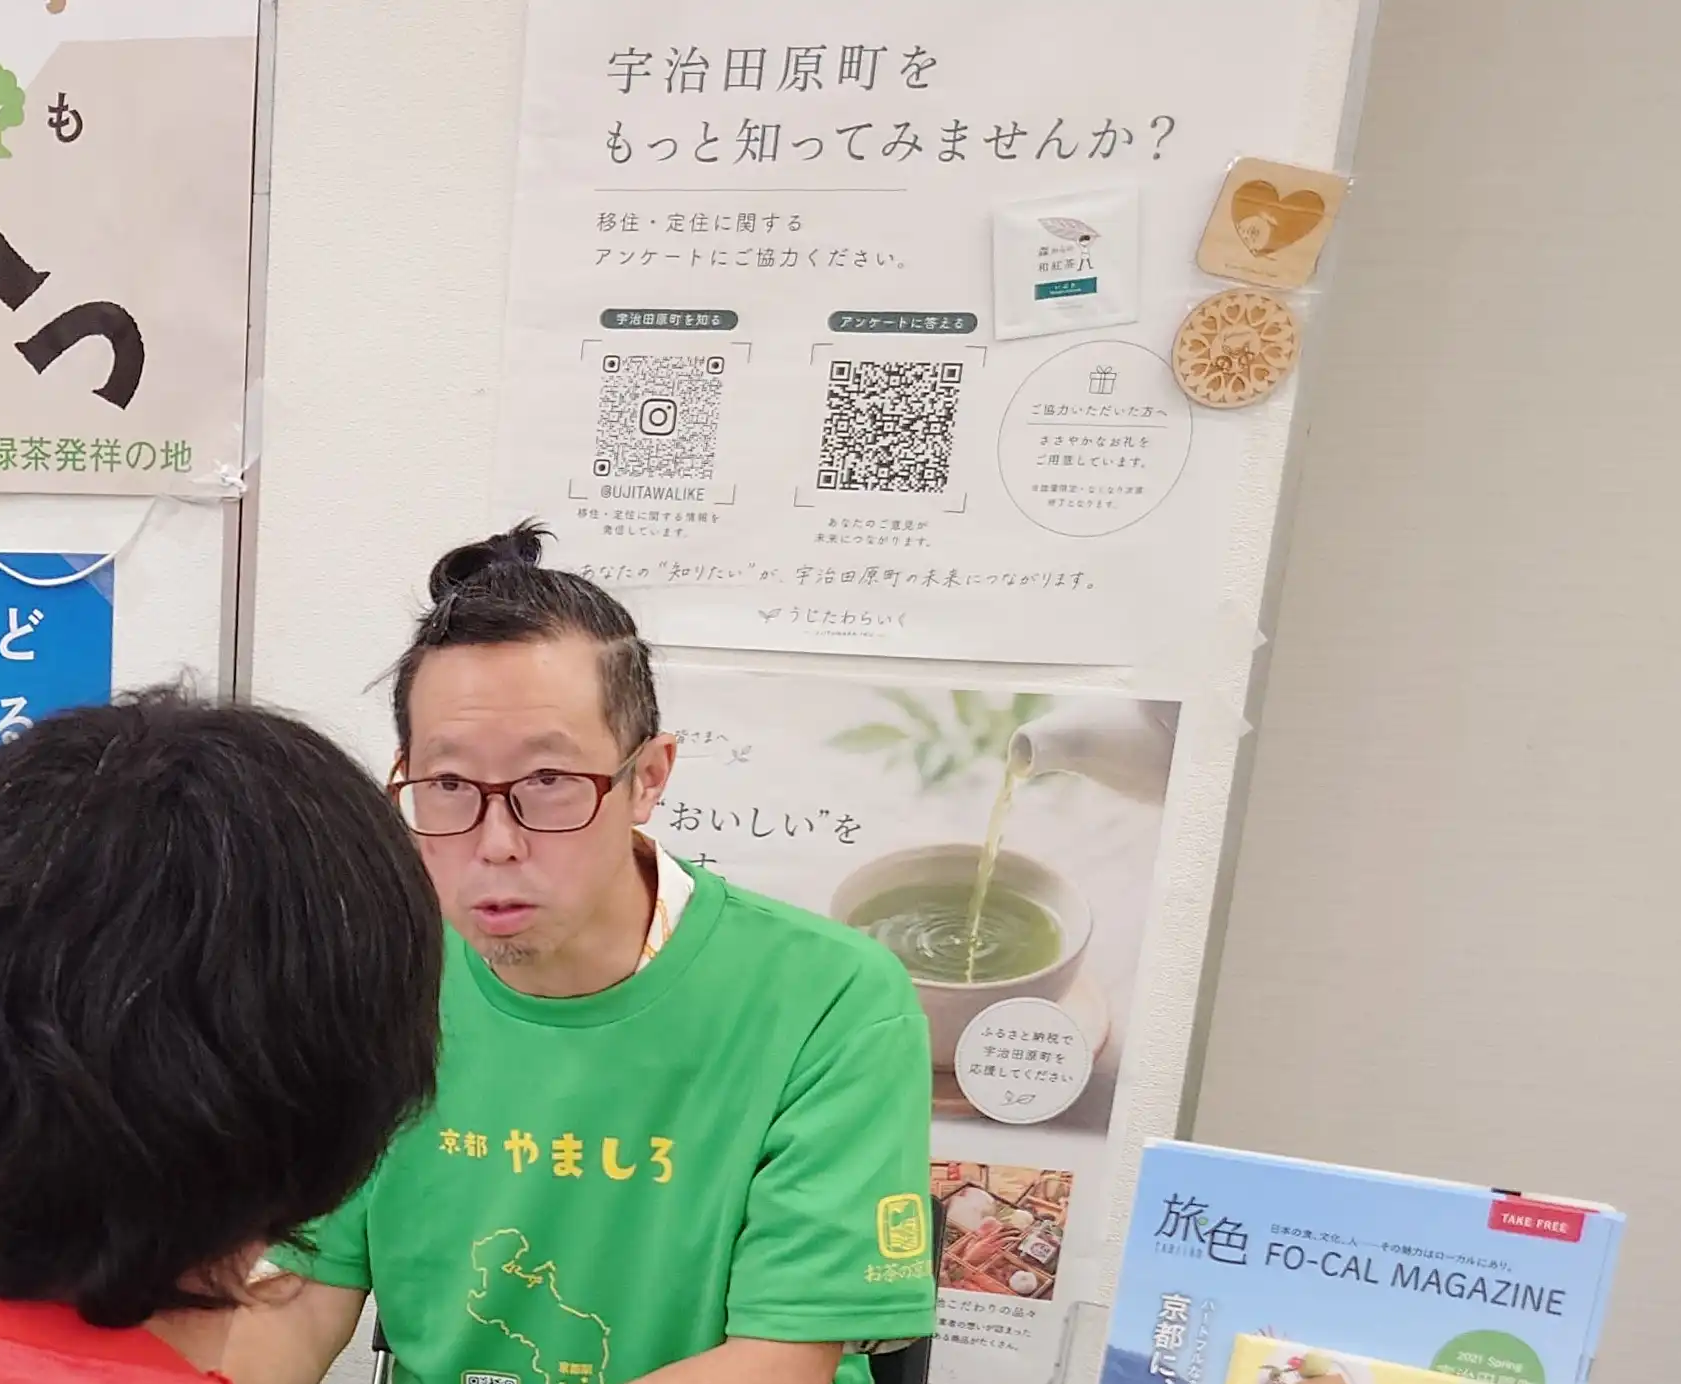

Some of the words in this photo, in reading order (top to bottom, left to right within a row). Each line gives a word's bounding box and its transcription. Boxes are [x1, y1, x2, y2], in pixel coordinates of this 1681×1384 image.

[607, 43, 940, 96] 宇治田原町を
[605, 113, 1178, 166] もっと知ってみませんか?
[596, 211, 804, 235] 移住・定住に関する
[595, 247, 909, 271] アンケートにご協力ください。
[616, 312, 722, 327] 宇治田原町を知る
[839, 314, 966, 331] アンケートに答える
[1031, 403, 1169, 418] ご協力いただいた方へ
[1039, 435, 1151, 449] ささやかなお礼を
[600, 484, 706, 502] @UJITAWALIKE
[576, 507, 721, 525] 移住・定住に関する情報を
[827, 517, 930, 532] あなたのご意見が
[980, 1027, 1074, 1046] ふるさと納税で
[983, 1045, 1065, 1065] 宇治田原町を
[438, 1128, 489, 1159] 京都
[504, 1128, 676, 1184] やましろ
[1154, 1193, 1249, 1266] 旅色
[1500, 1211, 1532, 1229] TAKE
[1535, 1217, 1568, 1234] FREE
[1264, 1241, 1380, 1285] FO-CAL
[1389, 1261, 1567, 1317] MAGAZINE
[1455, 1350, 1484, 1365] 2021
[1486, 1355, 1524, 1374] Spring
